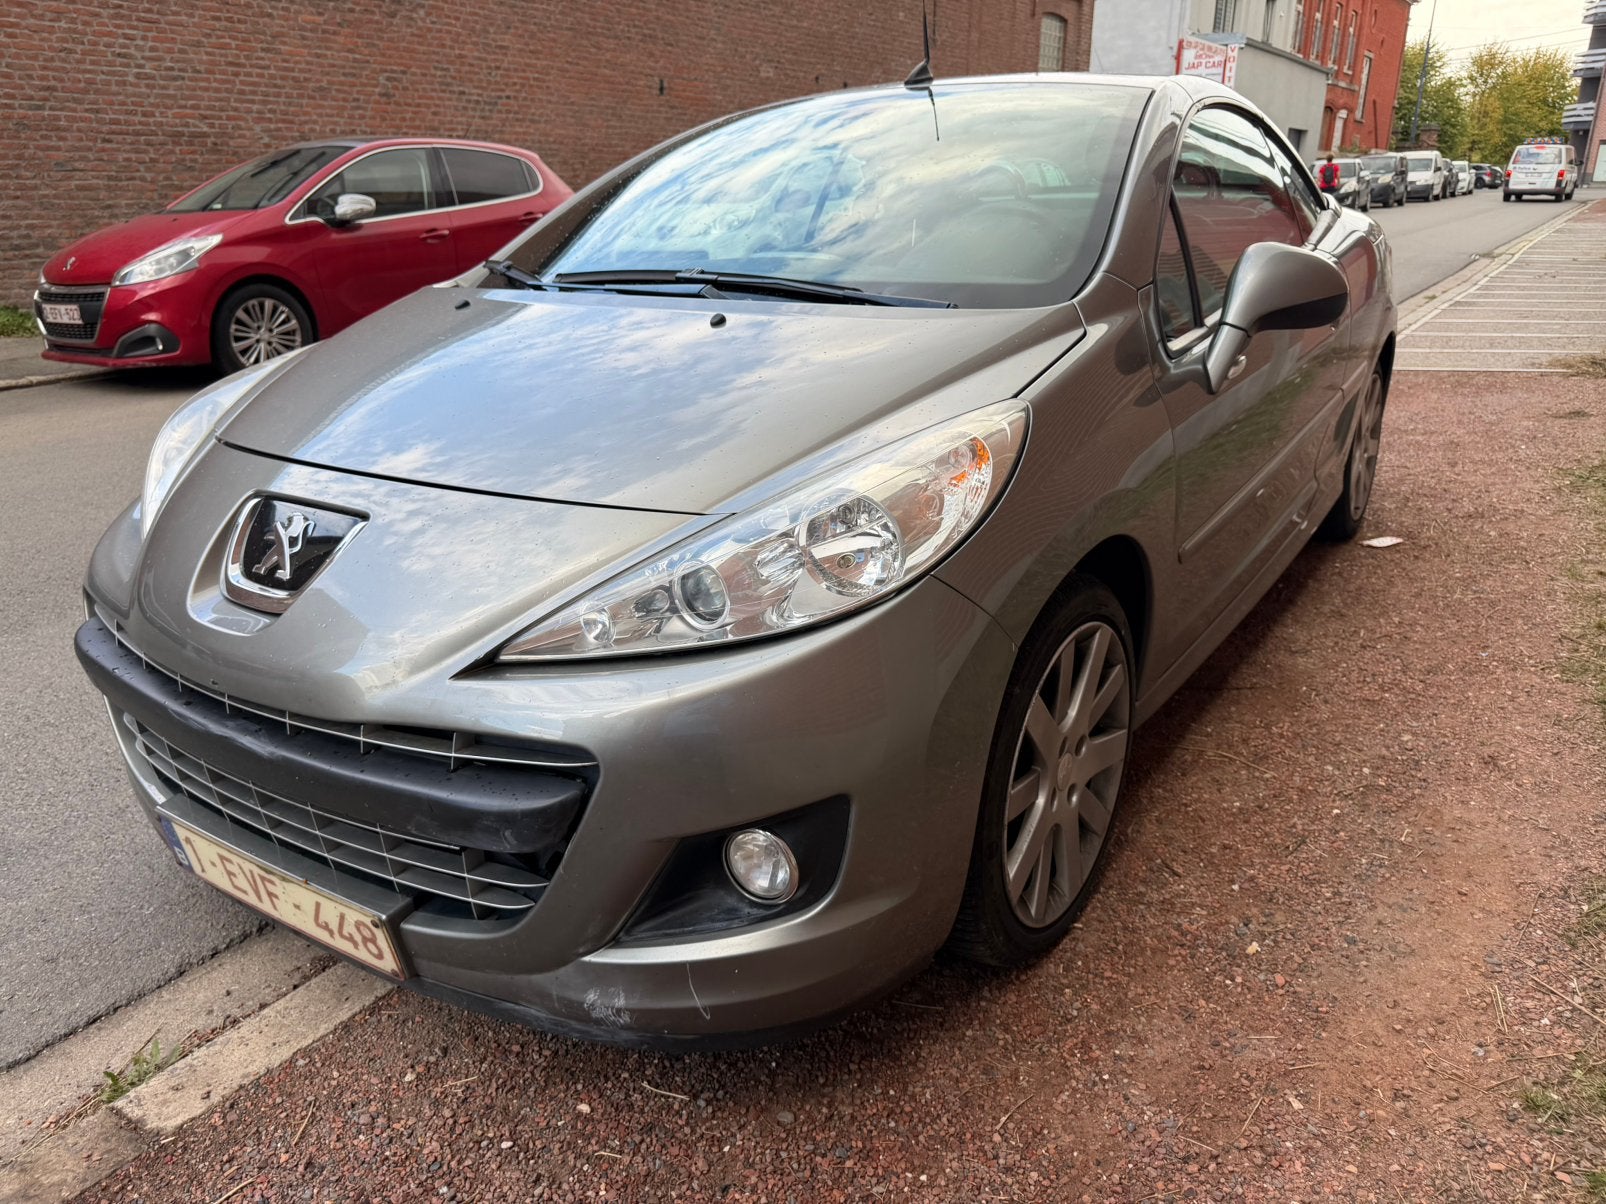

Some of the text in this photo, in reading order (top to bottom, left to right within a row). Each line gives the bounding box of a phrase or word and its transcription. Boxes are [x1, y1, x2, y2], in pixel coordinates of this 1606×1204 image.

[1185, 60, 1223, 70] JAP CAR
[184, 835, 385, 961] 1-EVF-448
